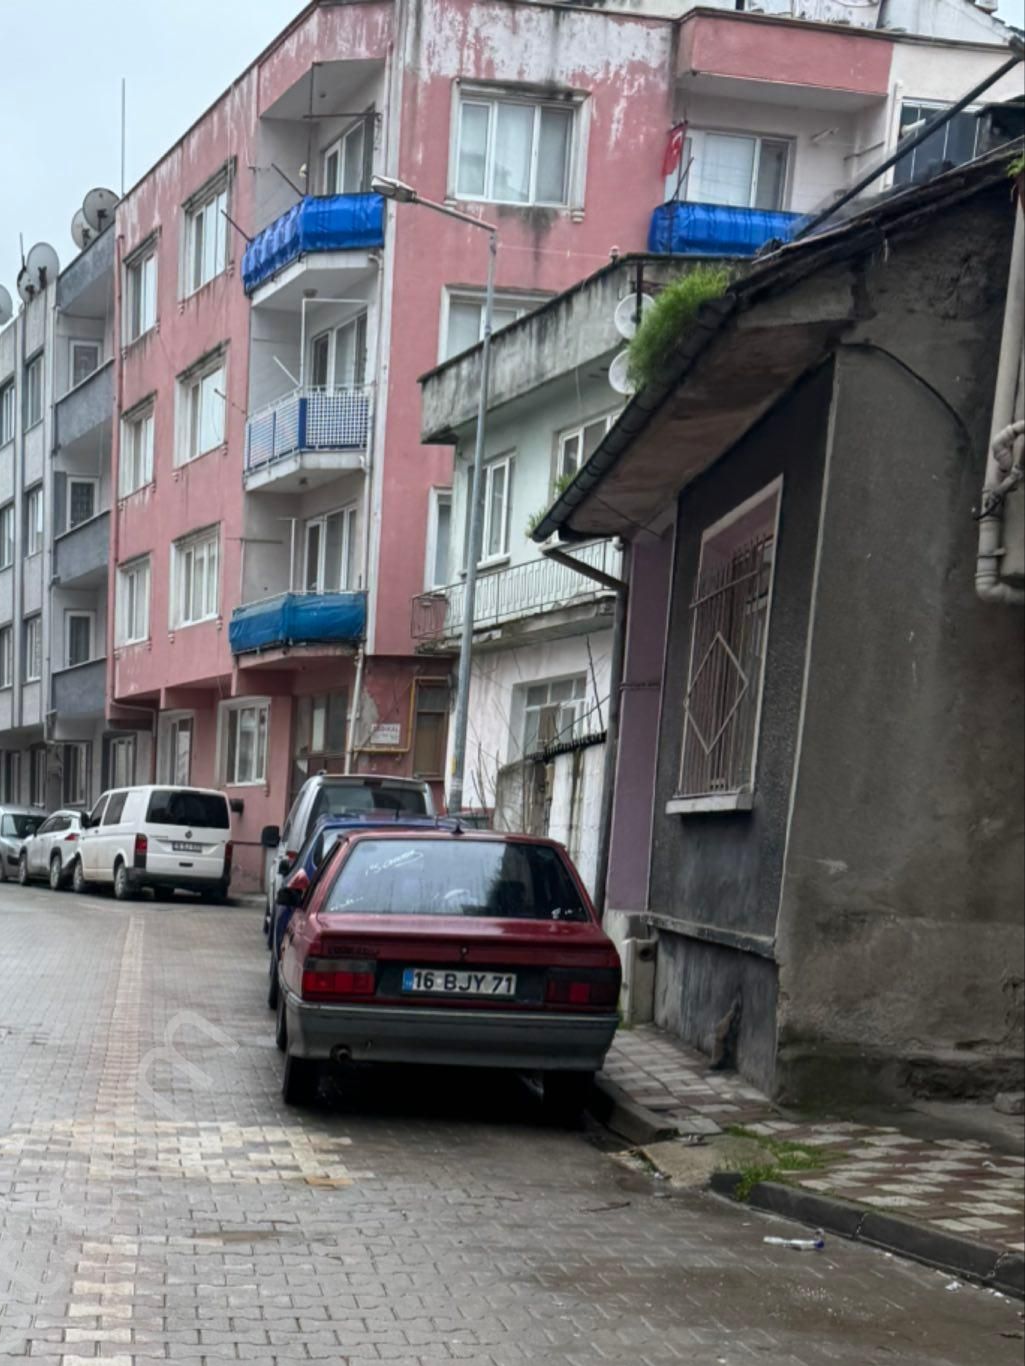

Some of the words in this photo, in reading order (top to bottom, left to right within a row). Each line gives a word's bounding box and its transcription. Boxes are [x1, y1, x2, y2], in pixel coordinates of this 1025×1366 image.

[414, 971, 435, 989] 16
[443, 973, 486, 991] BJY
[492, 975, 513, 993] 71
